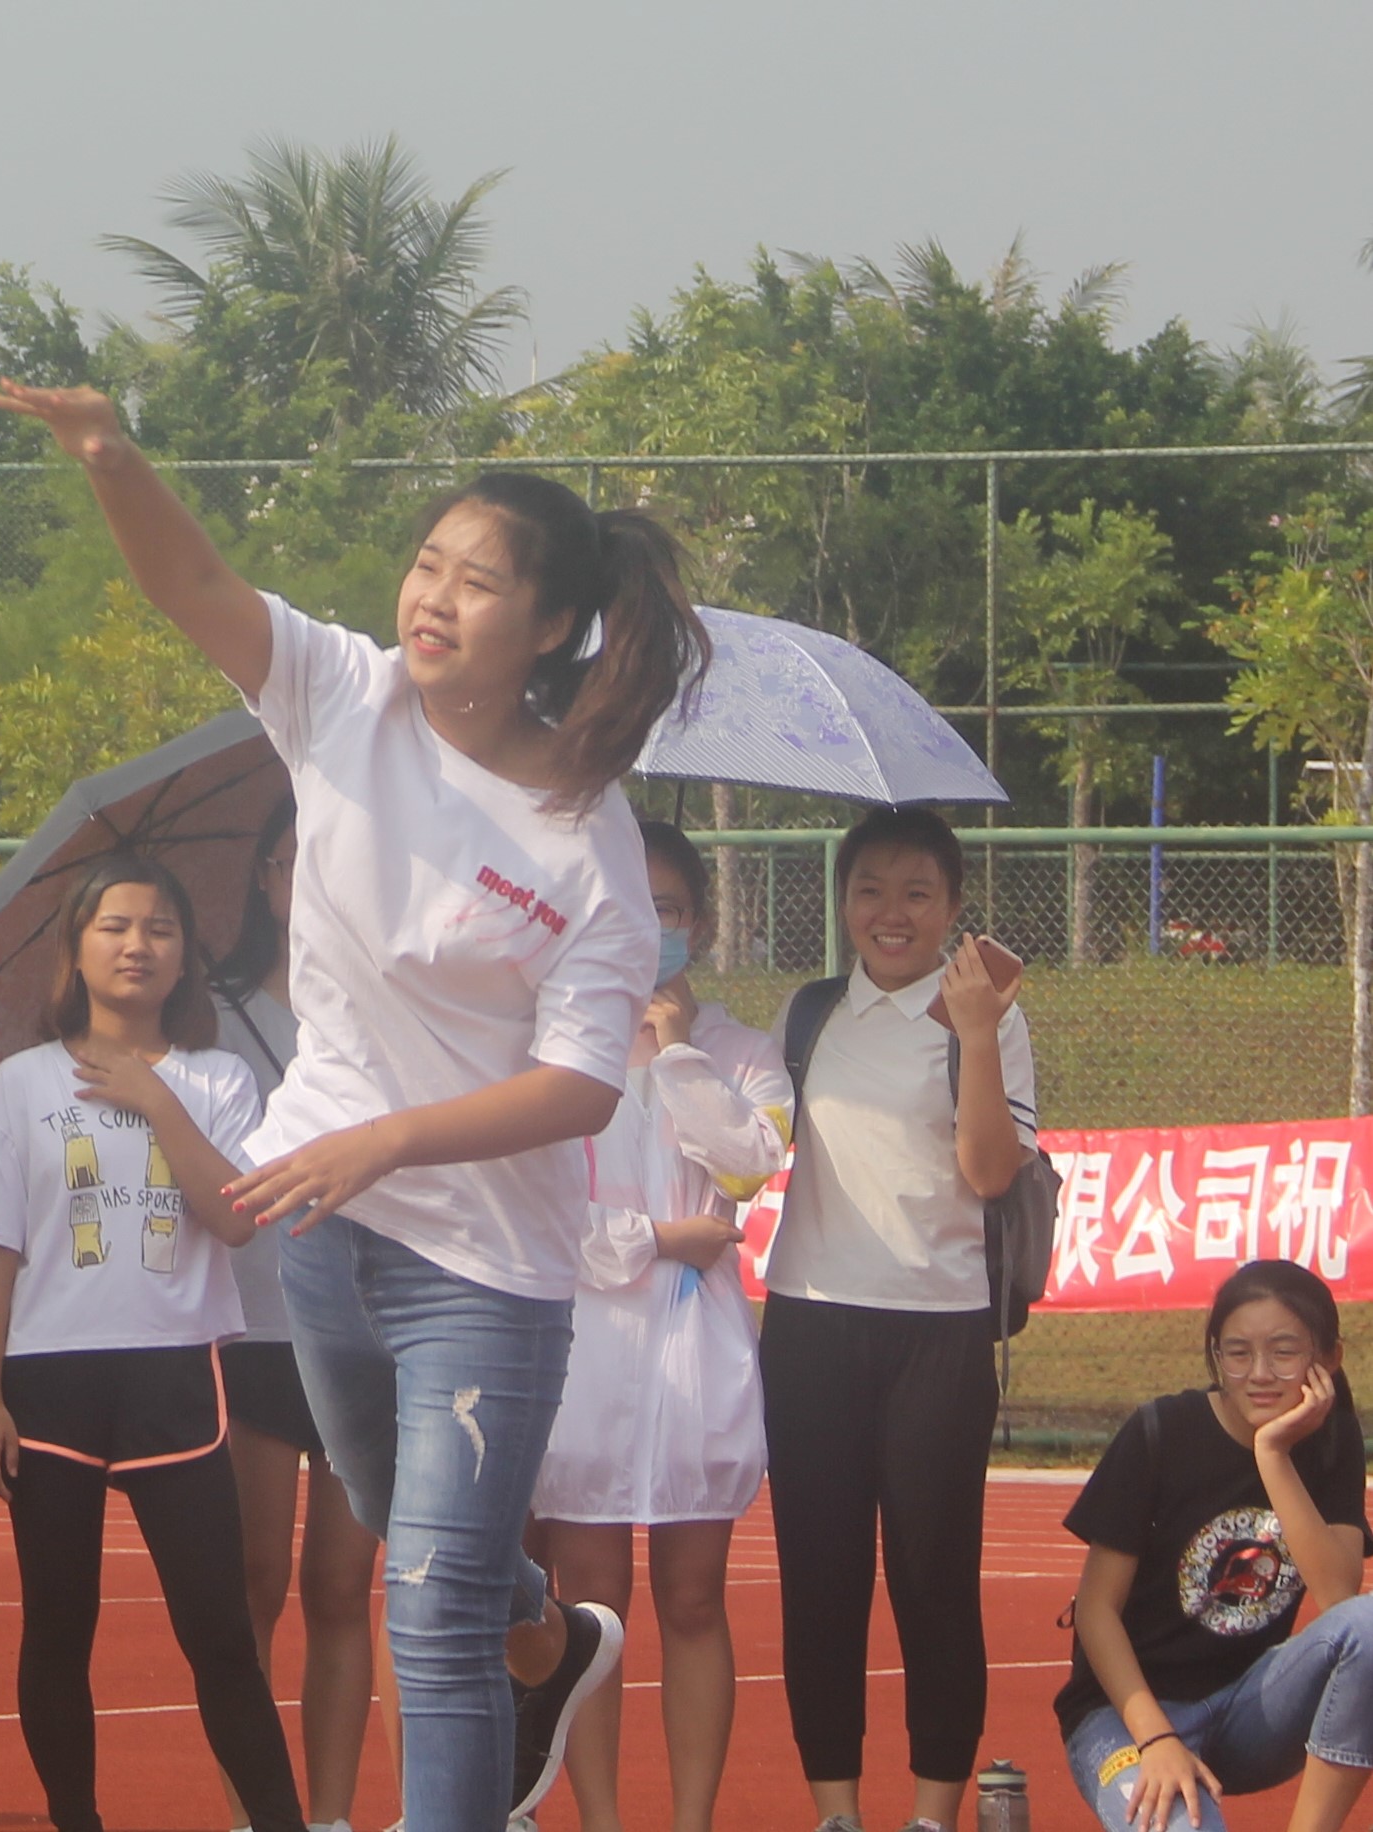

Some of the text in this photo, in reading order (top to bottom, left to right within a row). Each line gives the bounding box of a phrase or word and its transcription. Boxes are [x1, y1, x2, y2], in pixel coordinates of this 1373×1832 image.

[40, 1105, 150, 1132] THE COUN
[100, 1186, 132, 1209] HAS
